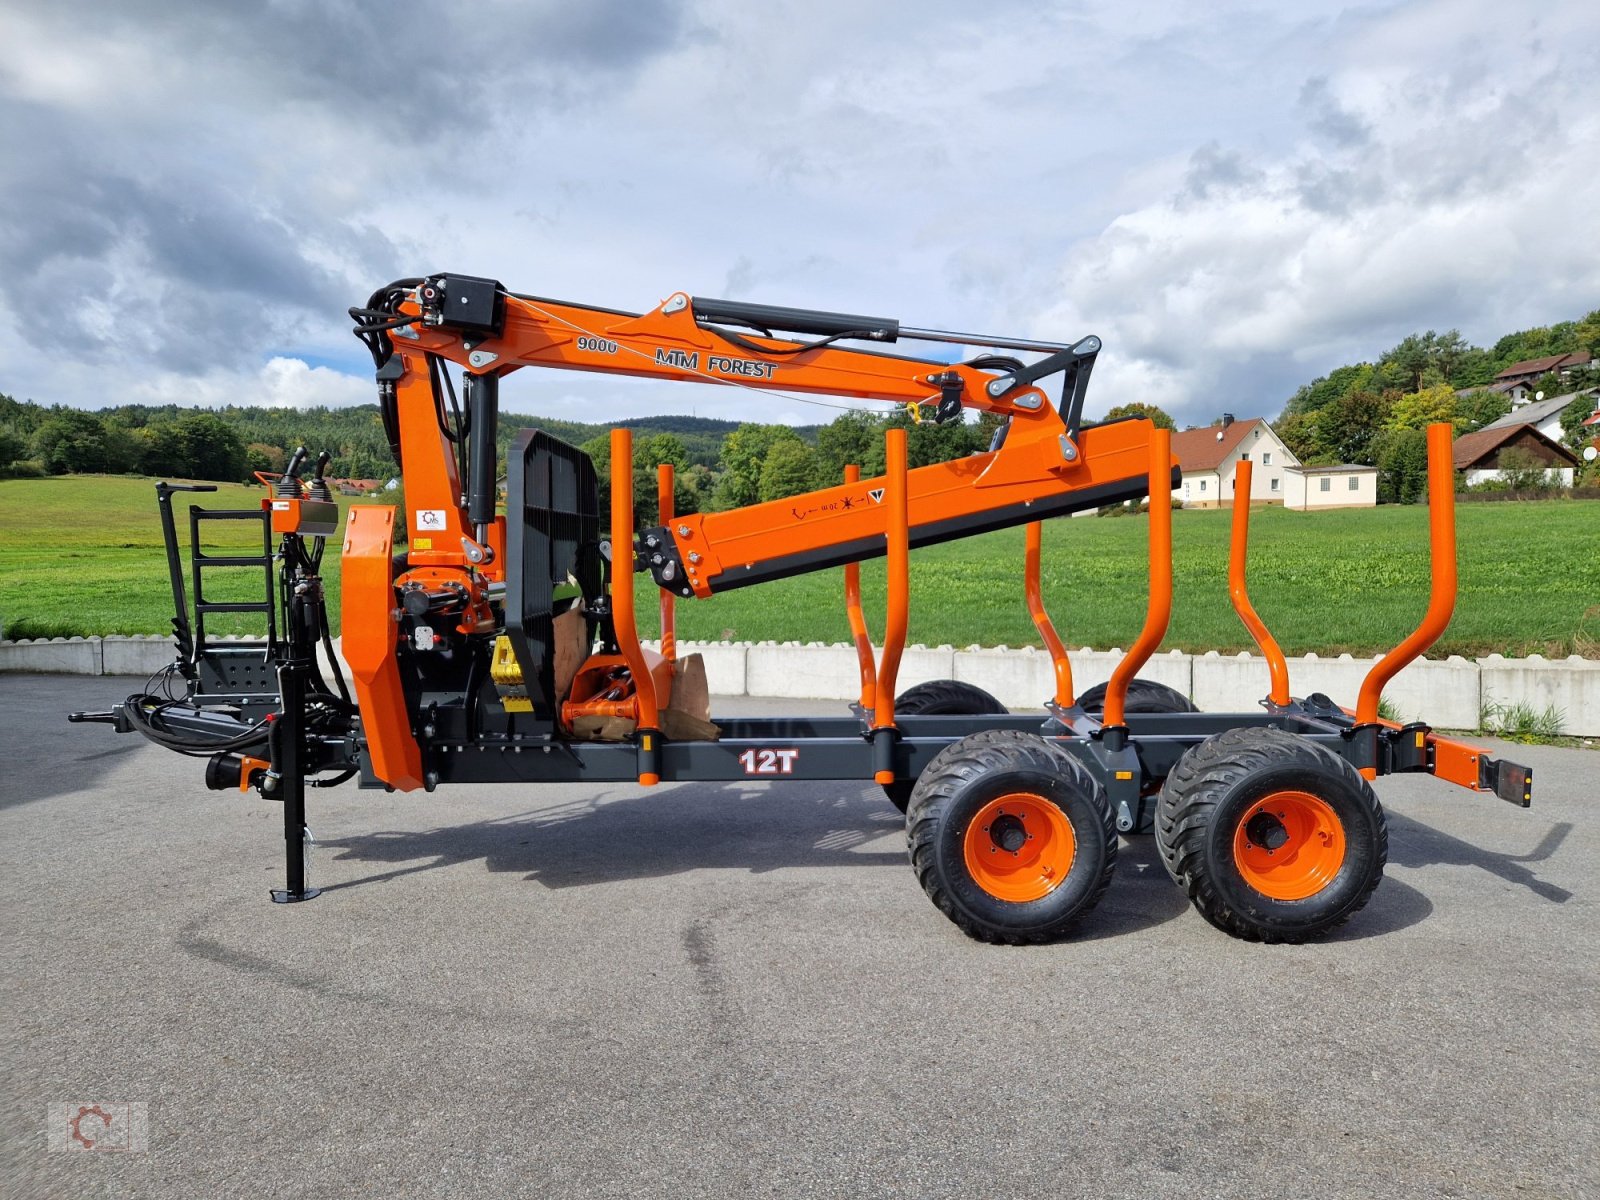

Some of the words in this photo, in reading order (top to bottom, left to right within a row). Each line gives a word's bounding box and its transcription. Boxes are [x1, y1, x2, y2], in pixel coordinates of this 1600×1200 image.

[577, 337, 617, 353] 9000
[655, 348, 698, 368] MTM
[708, 356, 777, 378] FOREST
[739, 748, 799, 774] 12T
